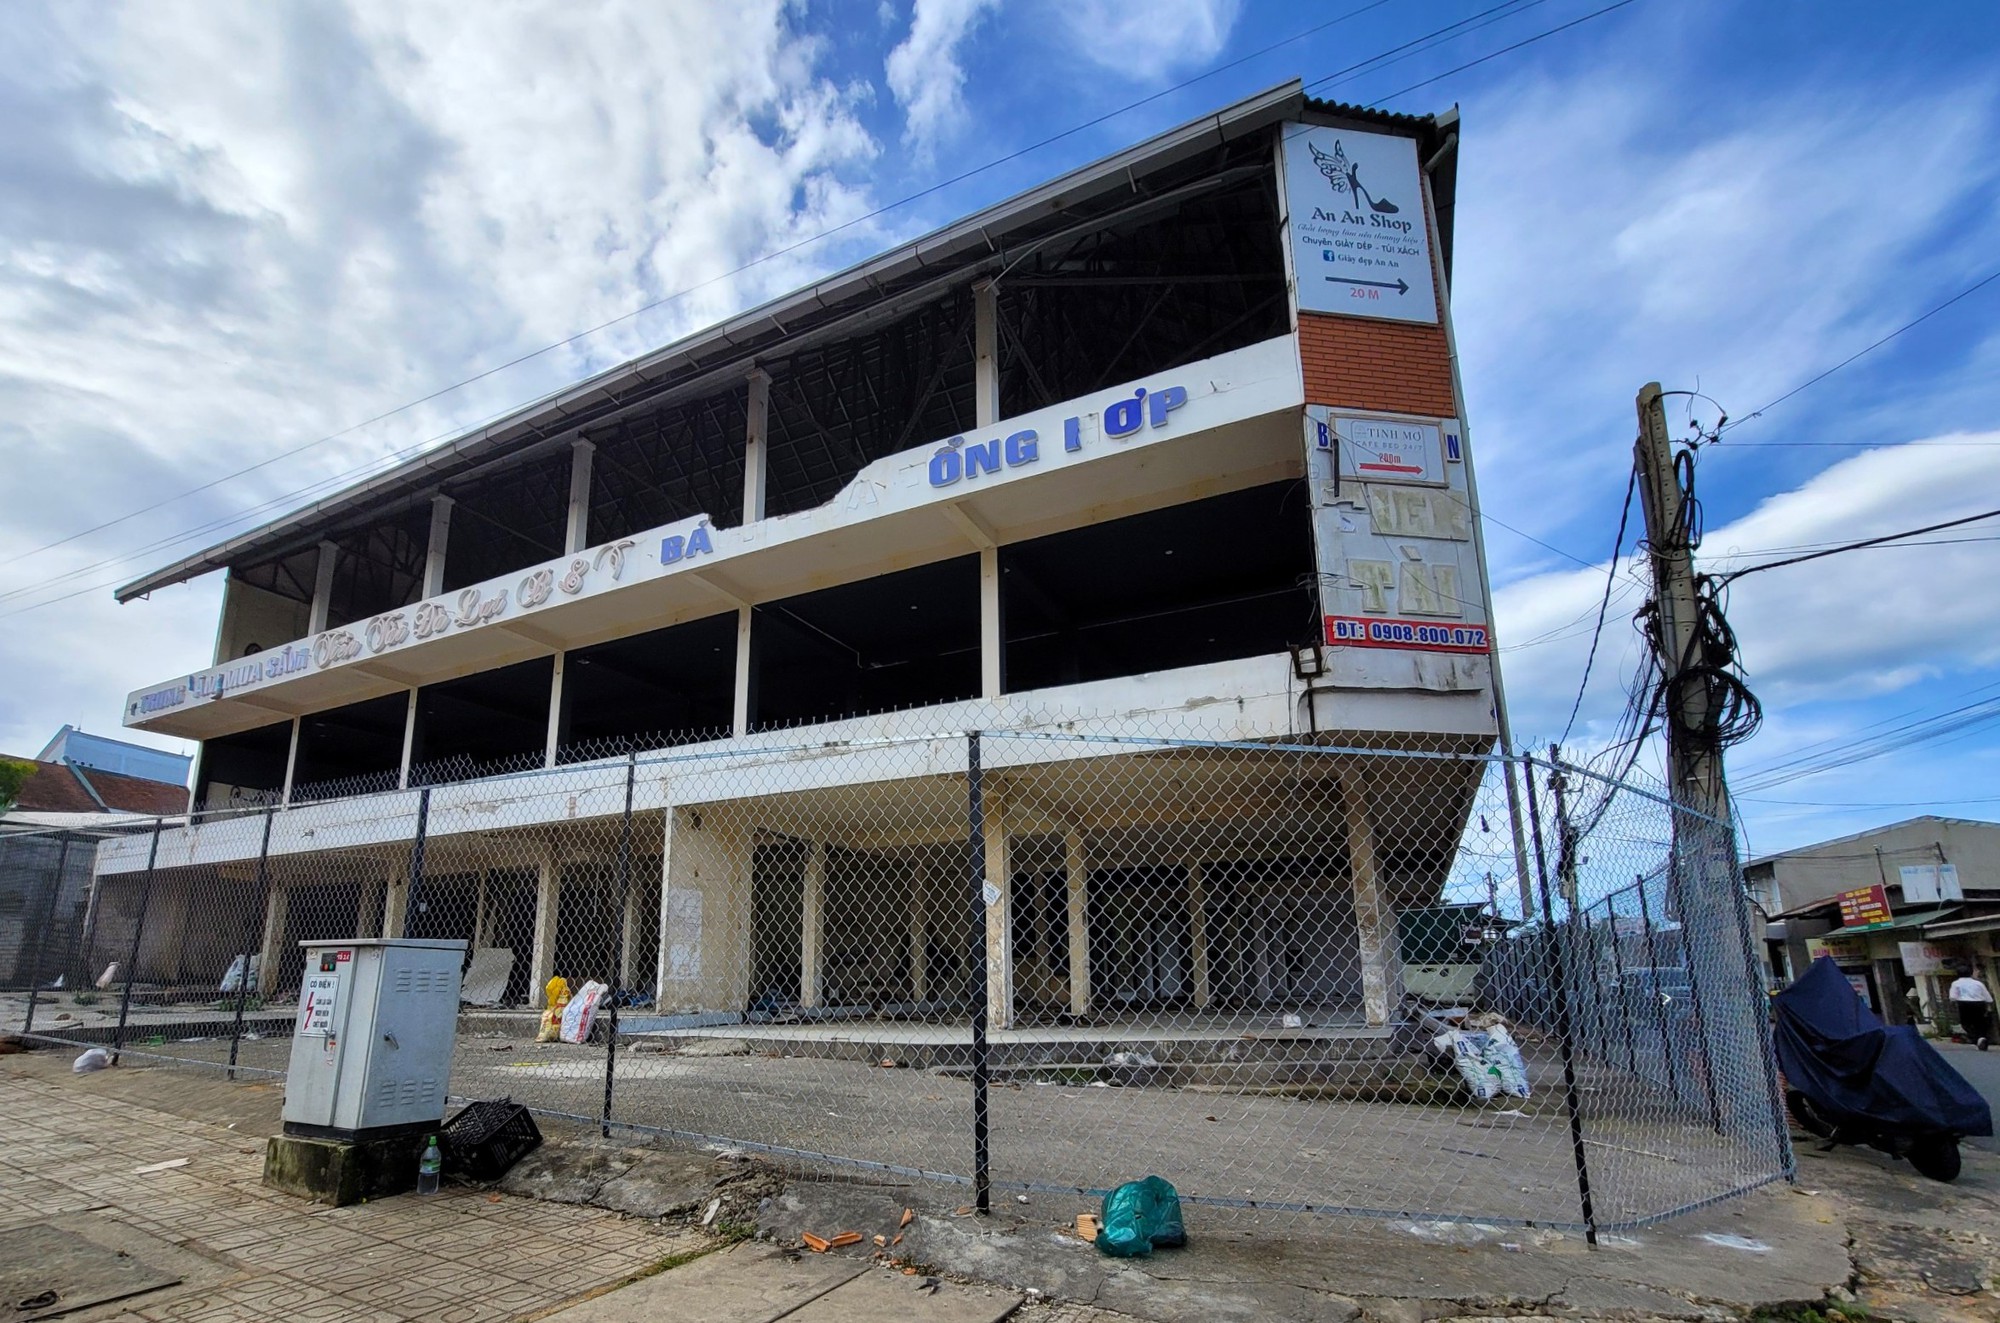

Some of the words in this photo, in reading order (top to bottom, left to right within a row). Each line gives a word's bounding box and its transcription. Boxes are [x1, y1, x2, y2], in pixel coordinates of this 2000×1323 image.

[1311, 207, 1336, 222] An
[1341, 210, 1365, 225] An
[1369, 213, 1412, 234] Shop
[1302, 236, 1332, 247] Chuyên
[1335, 238, 1354, 249] GIÀY
[1356, 241, 1373, 251] DÉP
[1381, 243, 1395, 254] TÚI
[1397, 246, 1420, 256] XÁCH
[1375, 259, 1386, 267] An
[1387, 260, 1399, 268] An
[1350, 287, 1365, 298] 20
[1368, 288, 1379, 300] M
[1317, 422, 1329, 447] B
[1447, 434, 1460, 459] N
[1355, 440, 1379, 449] CAFE
[1378, 452, 1401, 464] 200m
[1335, 621, 1365, 640] ĐT:
[1371, 623, 1487, 646] 0908.800.072
[222, 661, 263, 691] MUA
